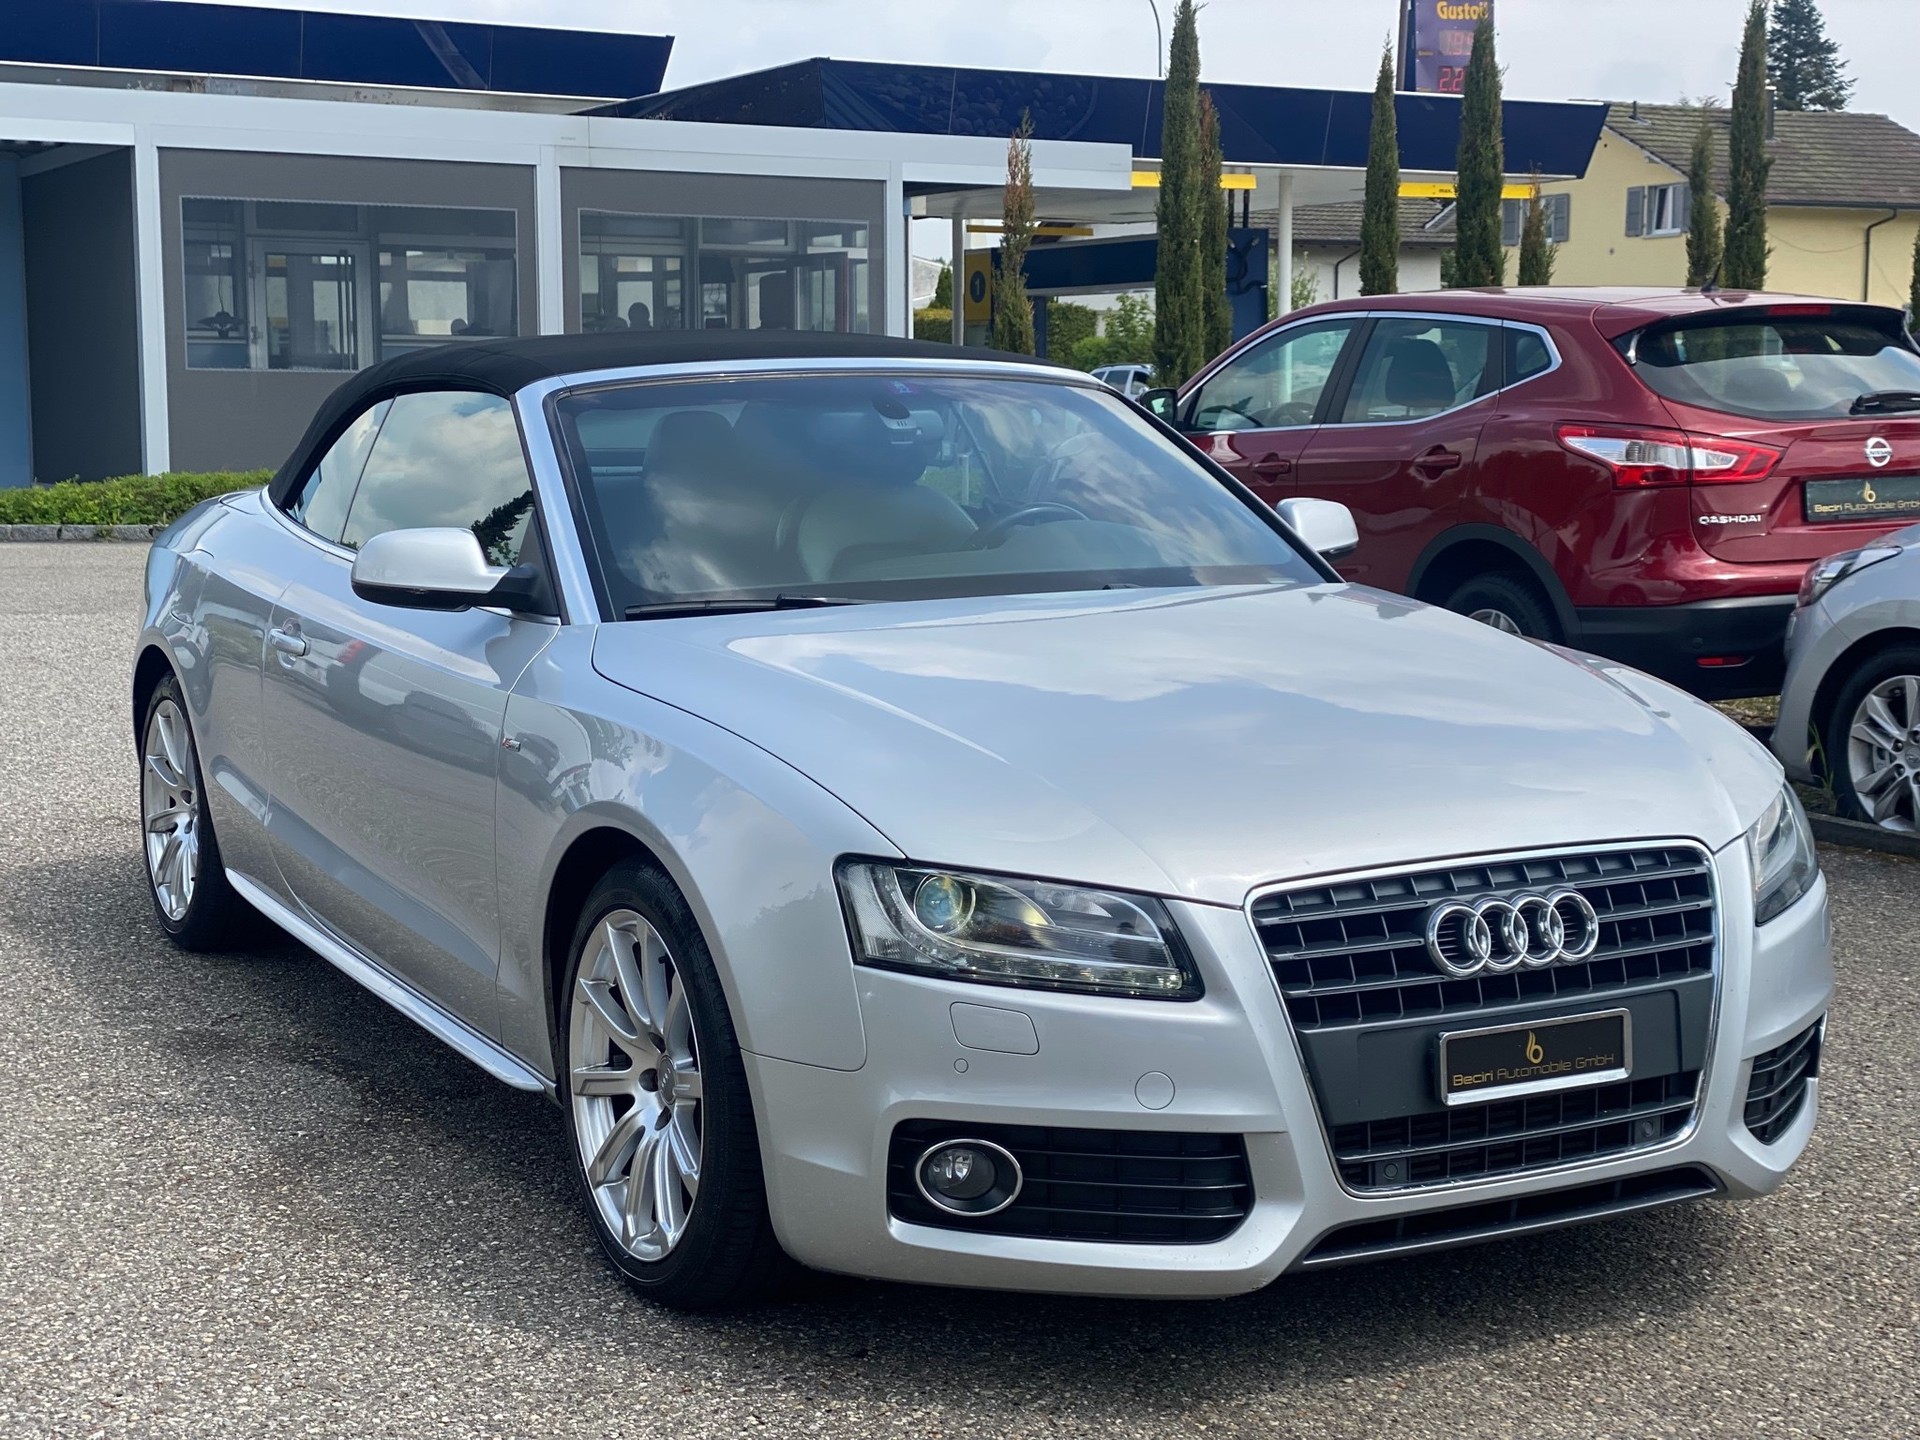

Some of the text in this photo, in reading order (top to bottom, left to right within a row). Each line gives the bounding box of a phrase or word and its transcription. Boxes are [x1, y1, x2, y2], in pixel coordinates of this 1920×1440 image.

[1439, 67, 1465, 92] 2.2
[1897, 499, 1920, 509] Gmb
[1497, 1059, 1572, 1079] Automobile
[1575, 1053, 1615, 1070] GmbH
